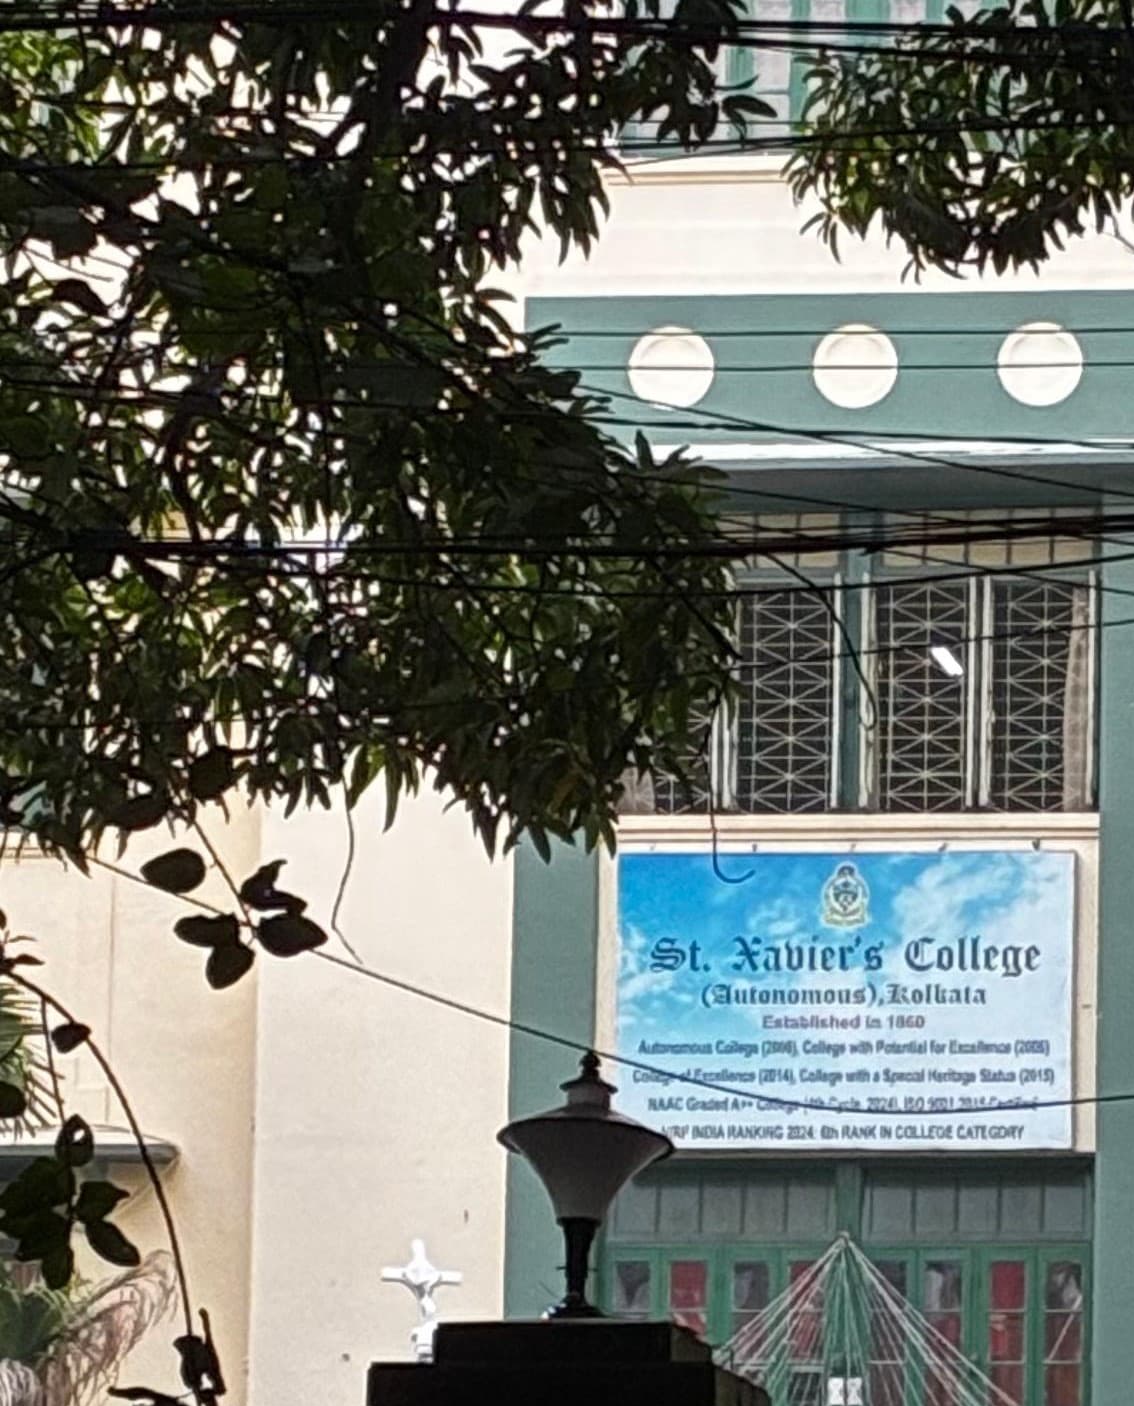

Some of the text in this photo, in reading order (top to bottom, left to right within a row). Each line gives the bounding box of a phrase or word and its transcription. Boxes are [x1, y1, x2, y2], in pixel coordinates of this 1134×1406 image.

[650, 936, 1042, 977] St. Xavier's College
[762, 1014, 860, 1030] Established
[715, 1040, 758, 1058] College
[802, 1040, 846, 1058] College
[849, 1041, 873, 1054] with
[875, 1040, 928, 1054] Potential
[929, 1040, 946, 1054] for
[799, 1068, 844, 1086] College
[845, 1069, 870, 1082] with
[882, 1068, 925, 1086] Special
[928, 1068, 976, 1086] Heritage
[979, 1068, 1017, 1083] Status
[691, 1125, 725, 1139] INDIA
[727, 1125, 784, 1139] RANKING
[841, 1125, 877, 1139] RANK
[895, 1125, 953, 1139] COLLEGE
[956, 1125, 1024, 1140] CATEGORY
